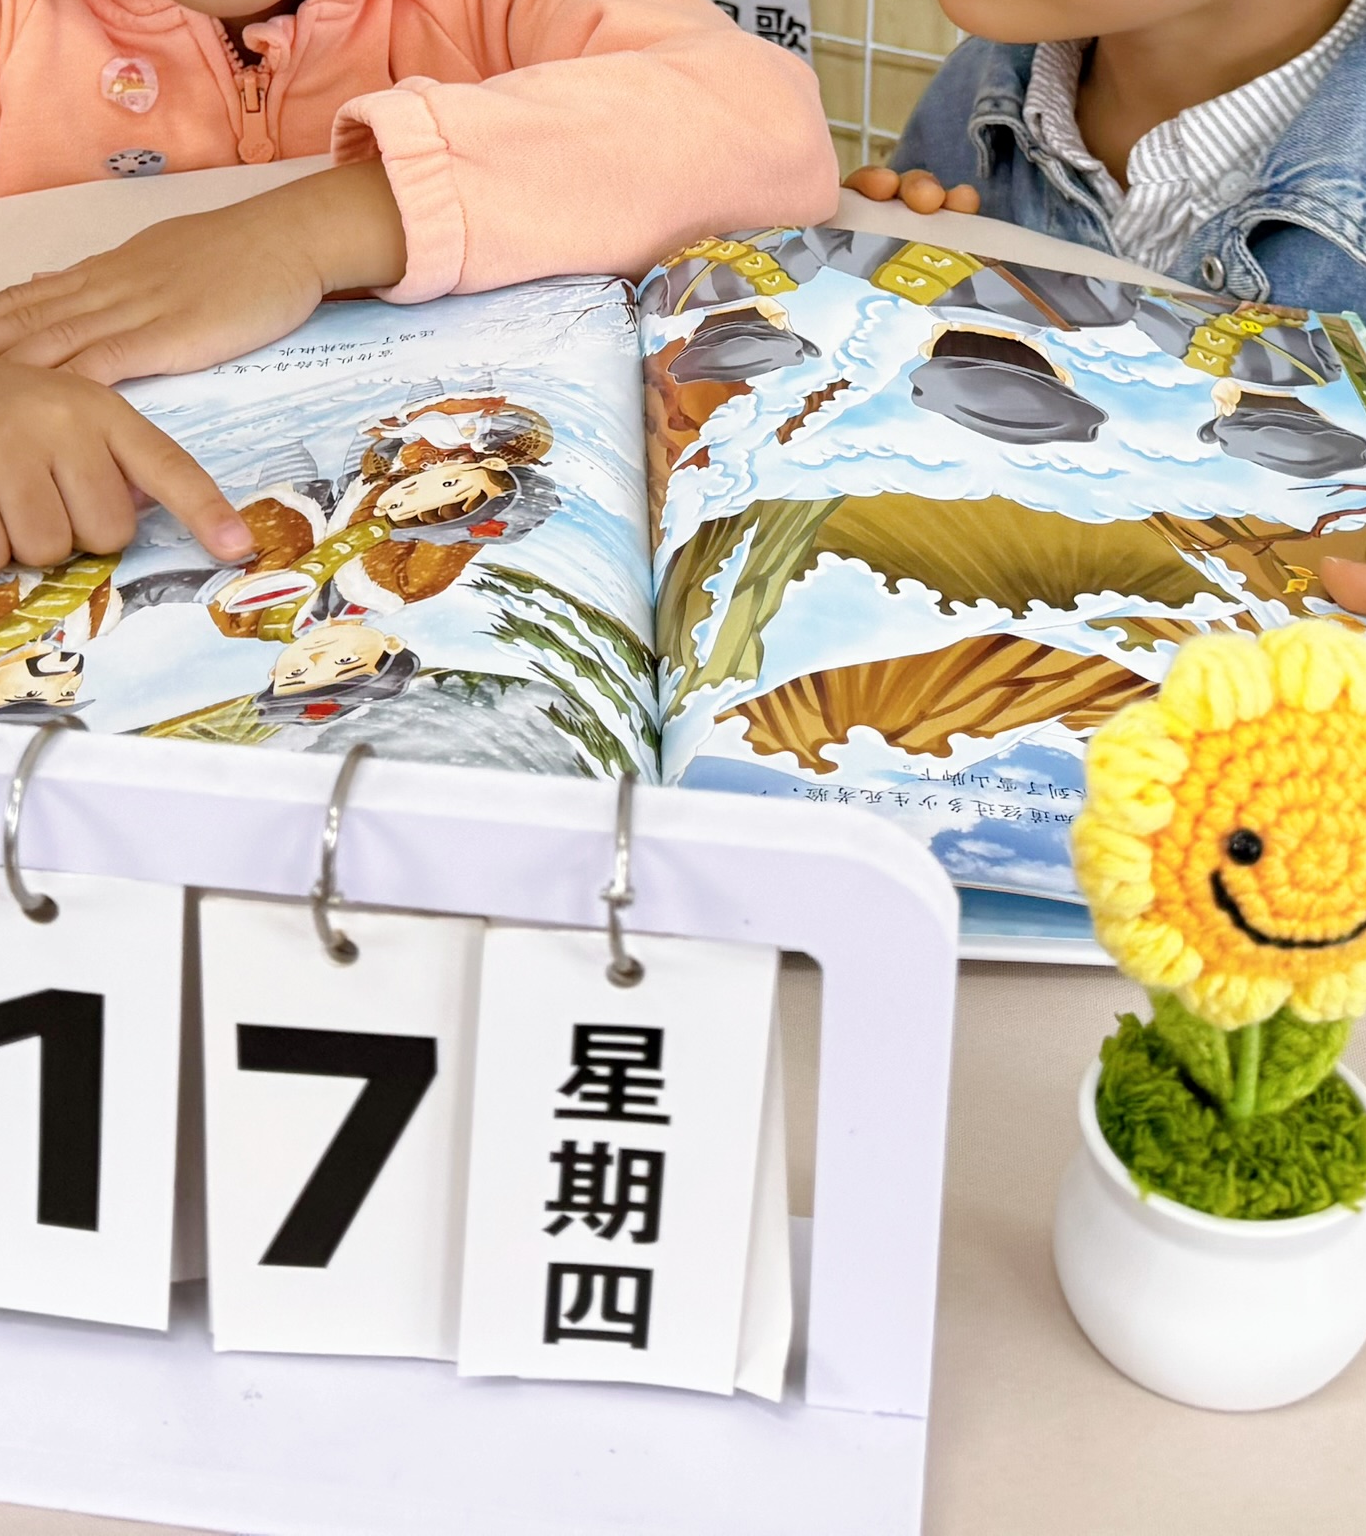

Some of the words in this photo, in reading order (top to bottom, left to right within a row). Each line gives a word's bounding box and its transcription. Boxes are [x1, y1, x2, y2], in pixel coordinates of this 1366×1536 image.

[761, 786, 1075, 825] 知道经过多少生死考验，
[543, 1024, 671, 1350] 星期四
